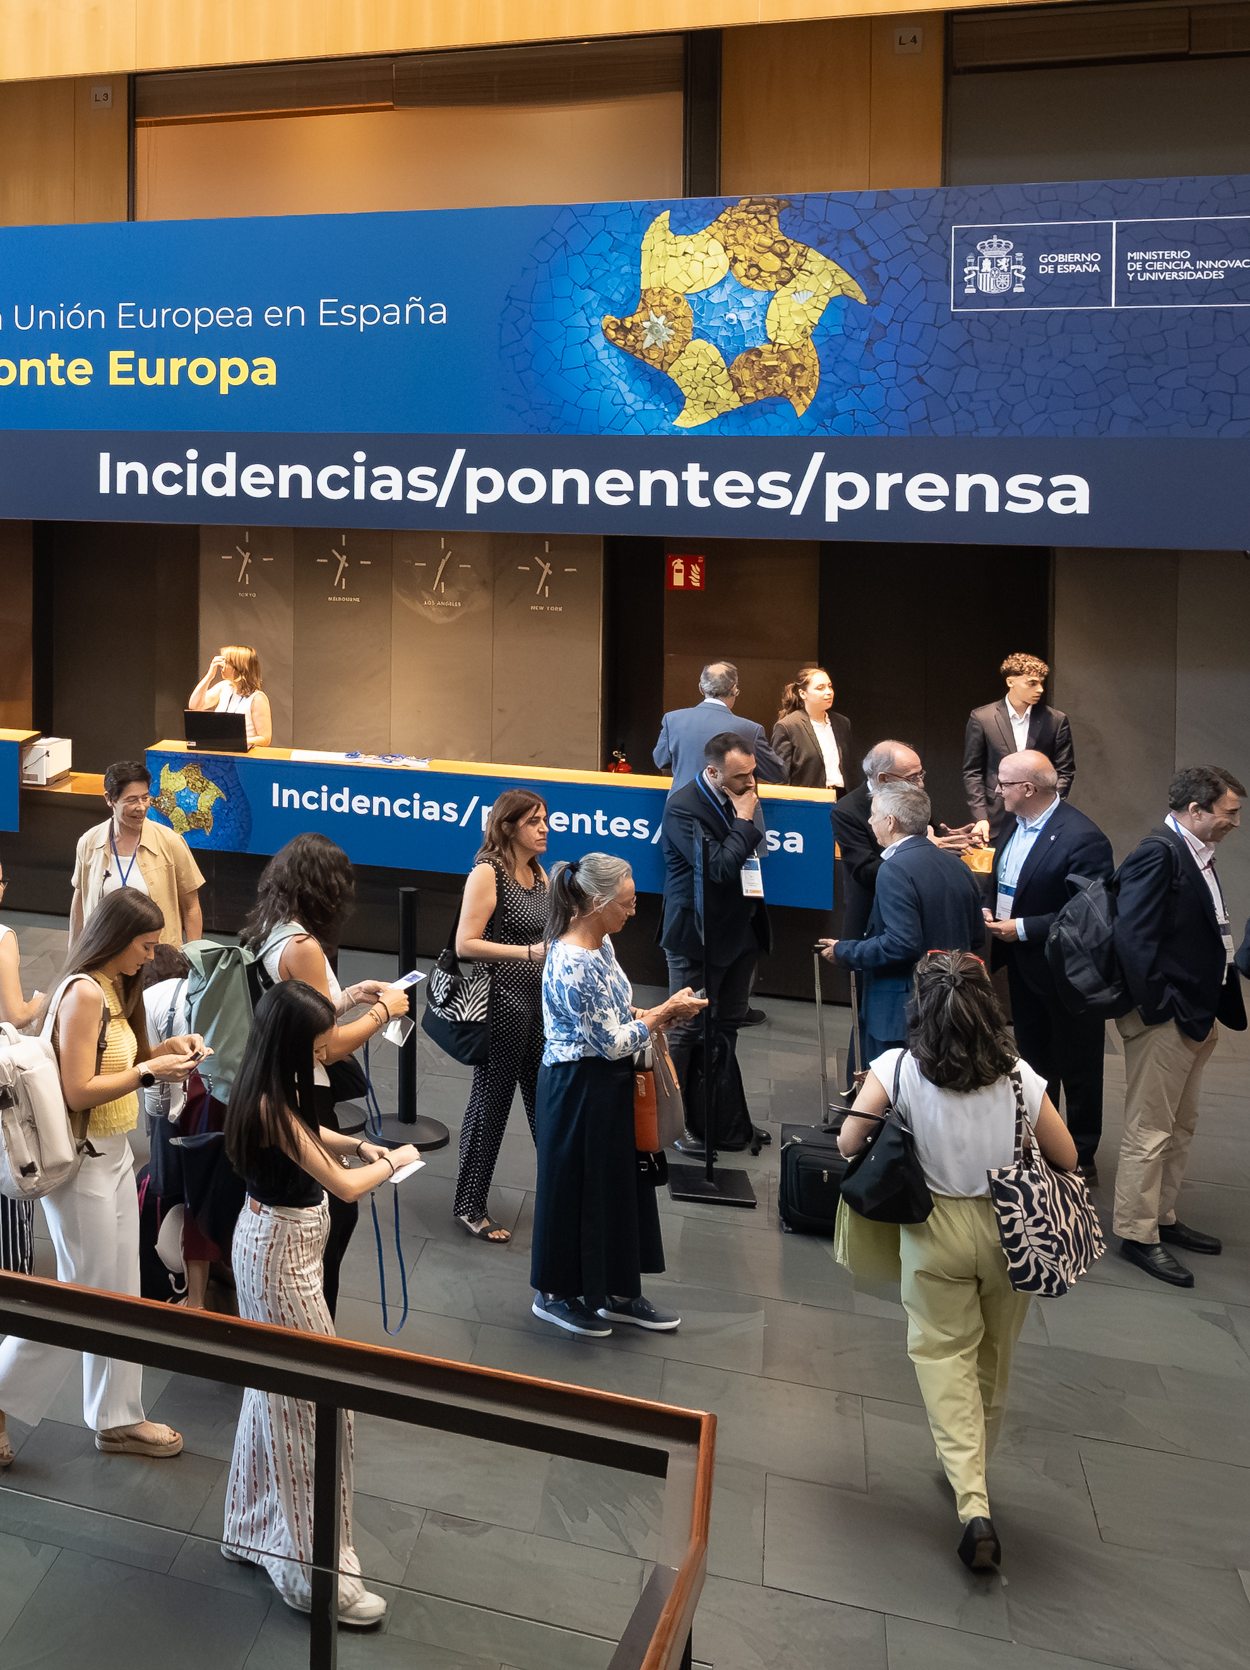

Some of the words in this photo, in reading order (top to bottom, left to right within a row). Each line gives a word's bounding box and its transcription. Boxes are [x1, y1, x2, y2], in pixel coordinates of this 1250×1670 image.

[1038, 252, 1102, 264] GOBIERNO
[1127, 250, 1191, 261] MINISTERIO
[1038, 264, 1054, 274] DE
[1056, 261, 1101, 274] ESPAÑA
[1127, 261, 1143, 271] DE
[1145, 260, 1195, 272] CIENCIA,
[1126, 272, 1135, 281] Y
[1137, 270, 1225, 282] UNIVERSIDADES
[14, 302, 105, 331] Unión
[118, 302, 253, 335] Europea
[264, 305, 305, 328] en
[319, 296, 447, 333] España
[109, 350, 277, 395] Europa
[99, 448, 1090, 523] Incidencias/ponentes/prensa
